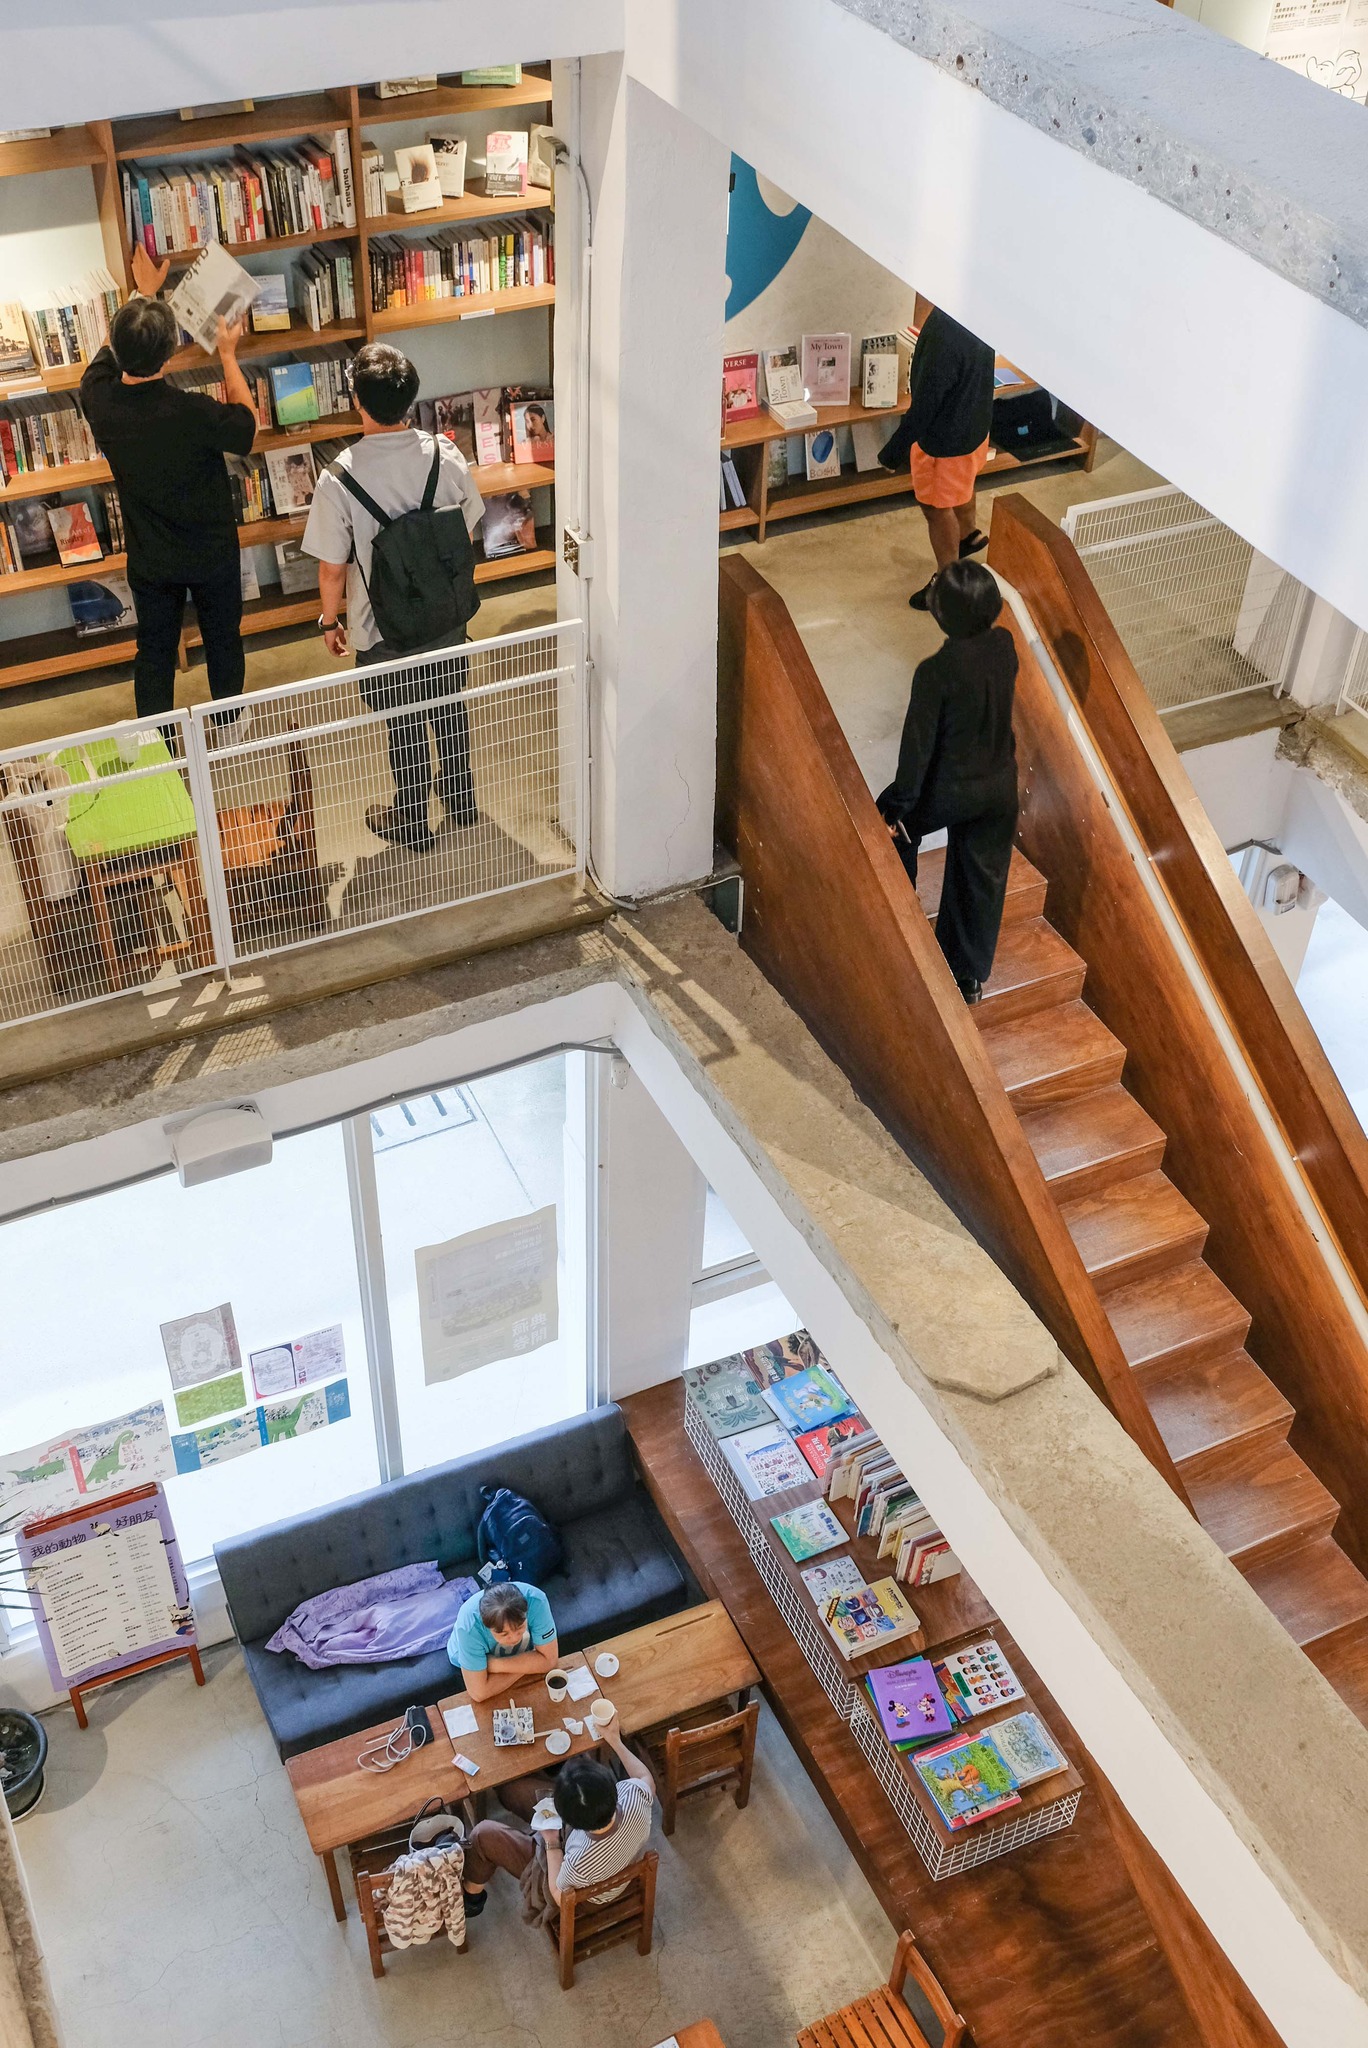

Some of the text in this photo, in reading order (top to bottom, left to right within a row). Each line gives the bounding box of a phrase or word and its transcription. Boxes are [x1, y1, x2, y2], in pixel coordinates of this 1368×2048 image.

[342, 167, 353, 208] bauhaus
[810, 343, 823, 352] My
[772, 388, 780, 402] My
[779, 376, 788, 401] Town
[72, 528, 84, 536] Art
[30, 1510, 156, 1559] 我的動物 好朋友
